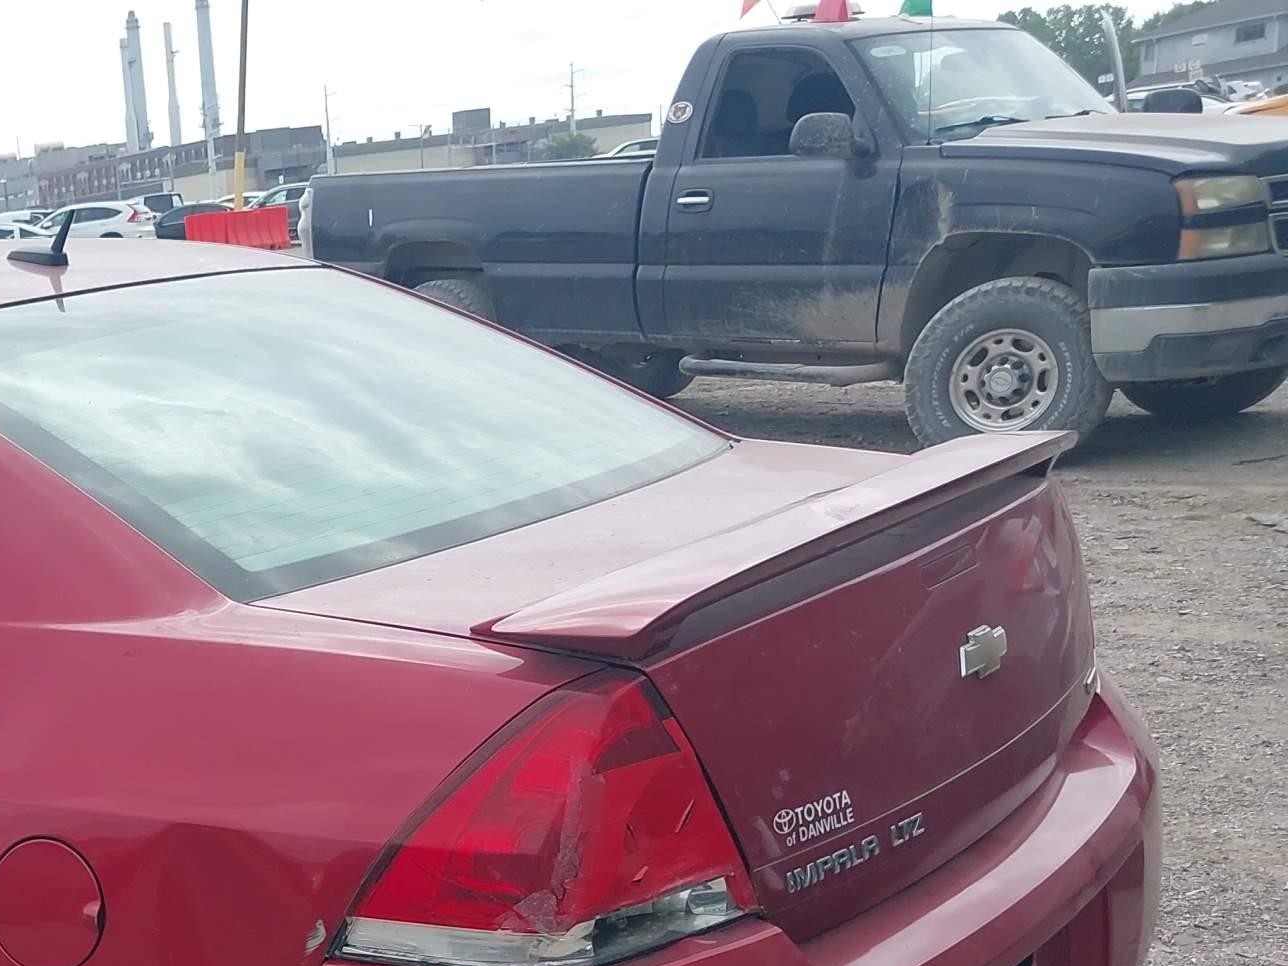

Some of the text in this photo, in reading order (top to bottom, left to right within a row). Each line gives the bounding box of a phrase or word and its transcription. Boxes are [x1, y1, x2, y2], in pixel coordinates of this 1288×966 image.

[786, 807, 855, 847] of DANVILLE
[794, 789, 852, 825] TOYOTA
[785, 811, 926, 894] IMPALA LTZ
